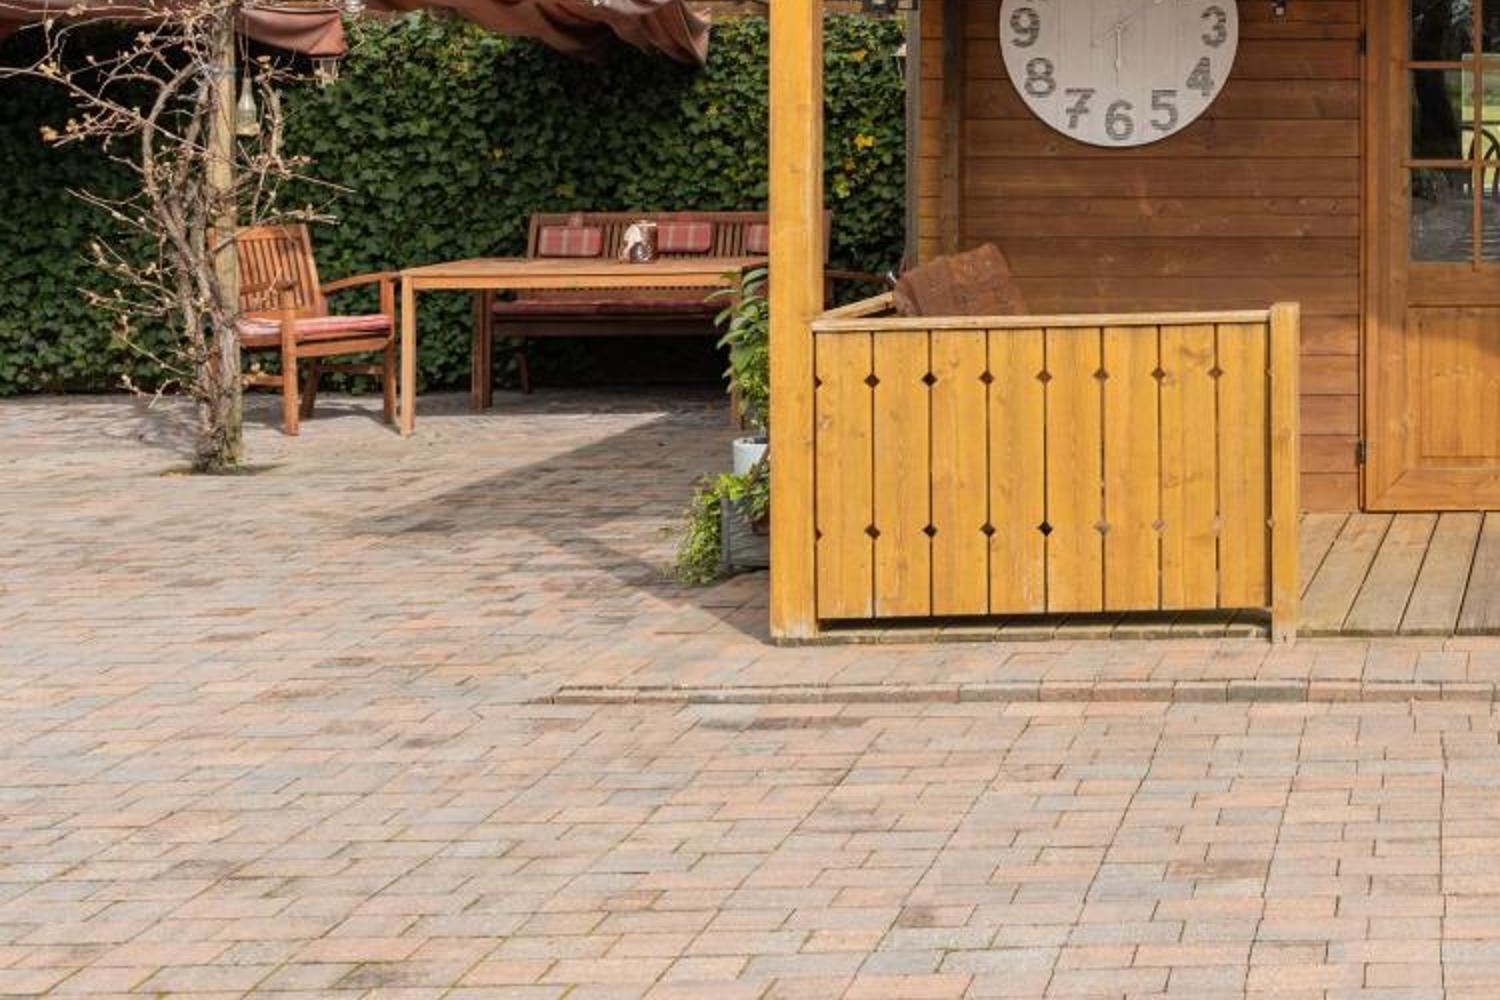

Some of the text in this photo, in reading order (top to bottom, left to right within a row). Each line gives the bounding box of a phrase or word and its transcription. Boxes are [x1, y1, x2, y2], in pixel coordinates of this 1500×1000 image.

[1009, 7, 1041, 48] 9
[1200, 5, 1228, 48] 3
[1024, 57, 1057, 98] 8
[1185, 56, 1215, 97] 4
[1064, 88, 1096, 129] 7
[1104, 99, 1134, 141] 6
[1150, 89, 1179, 131] 5
